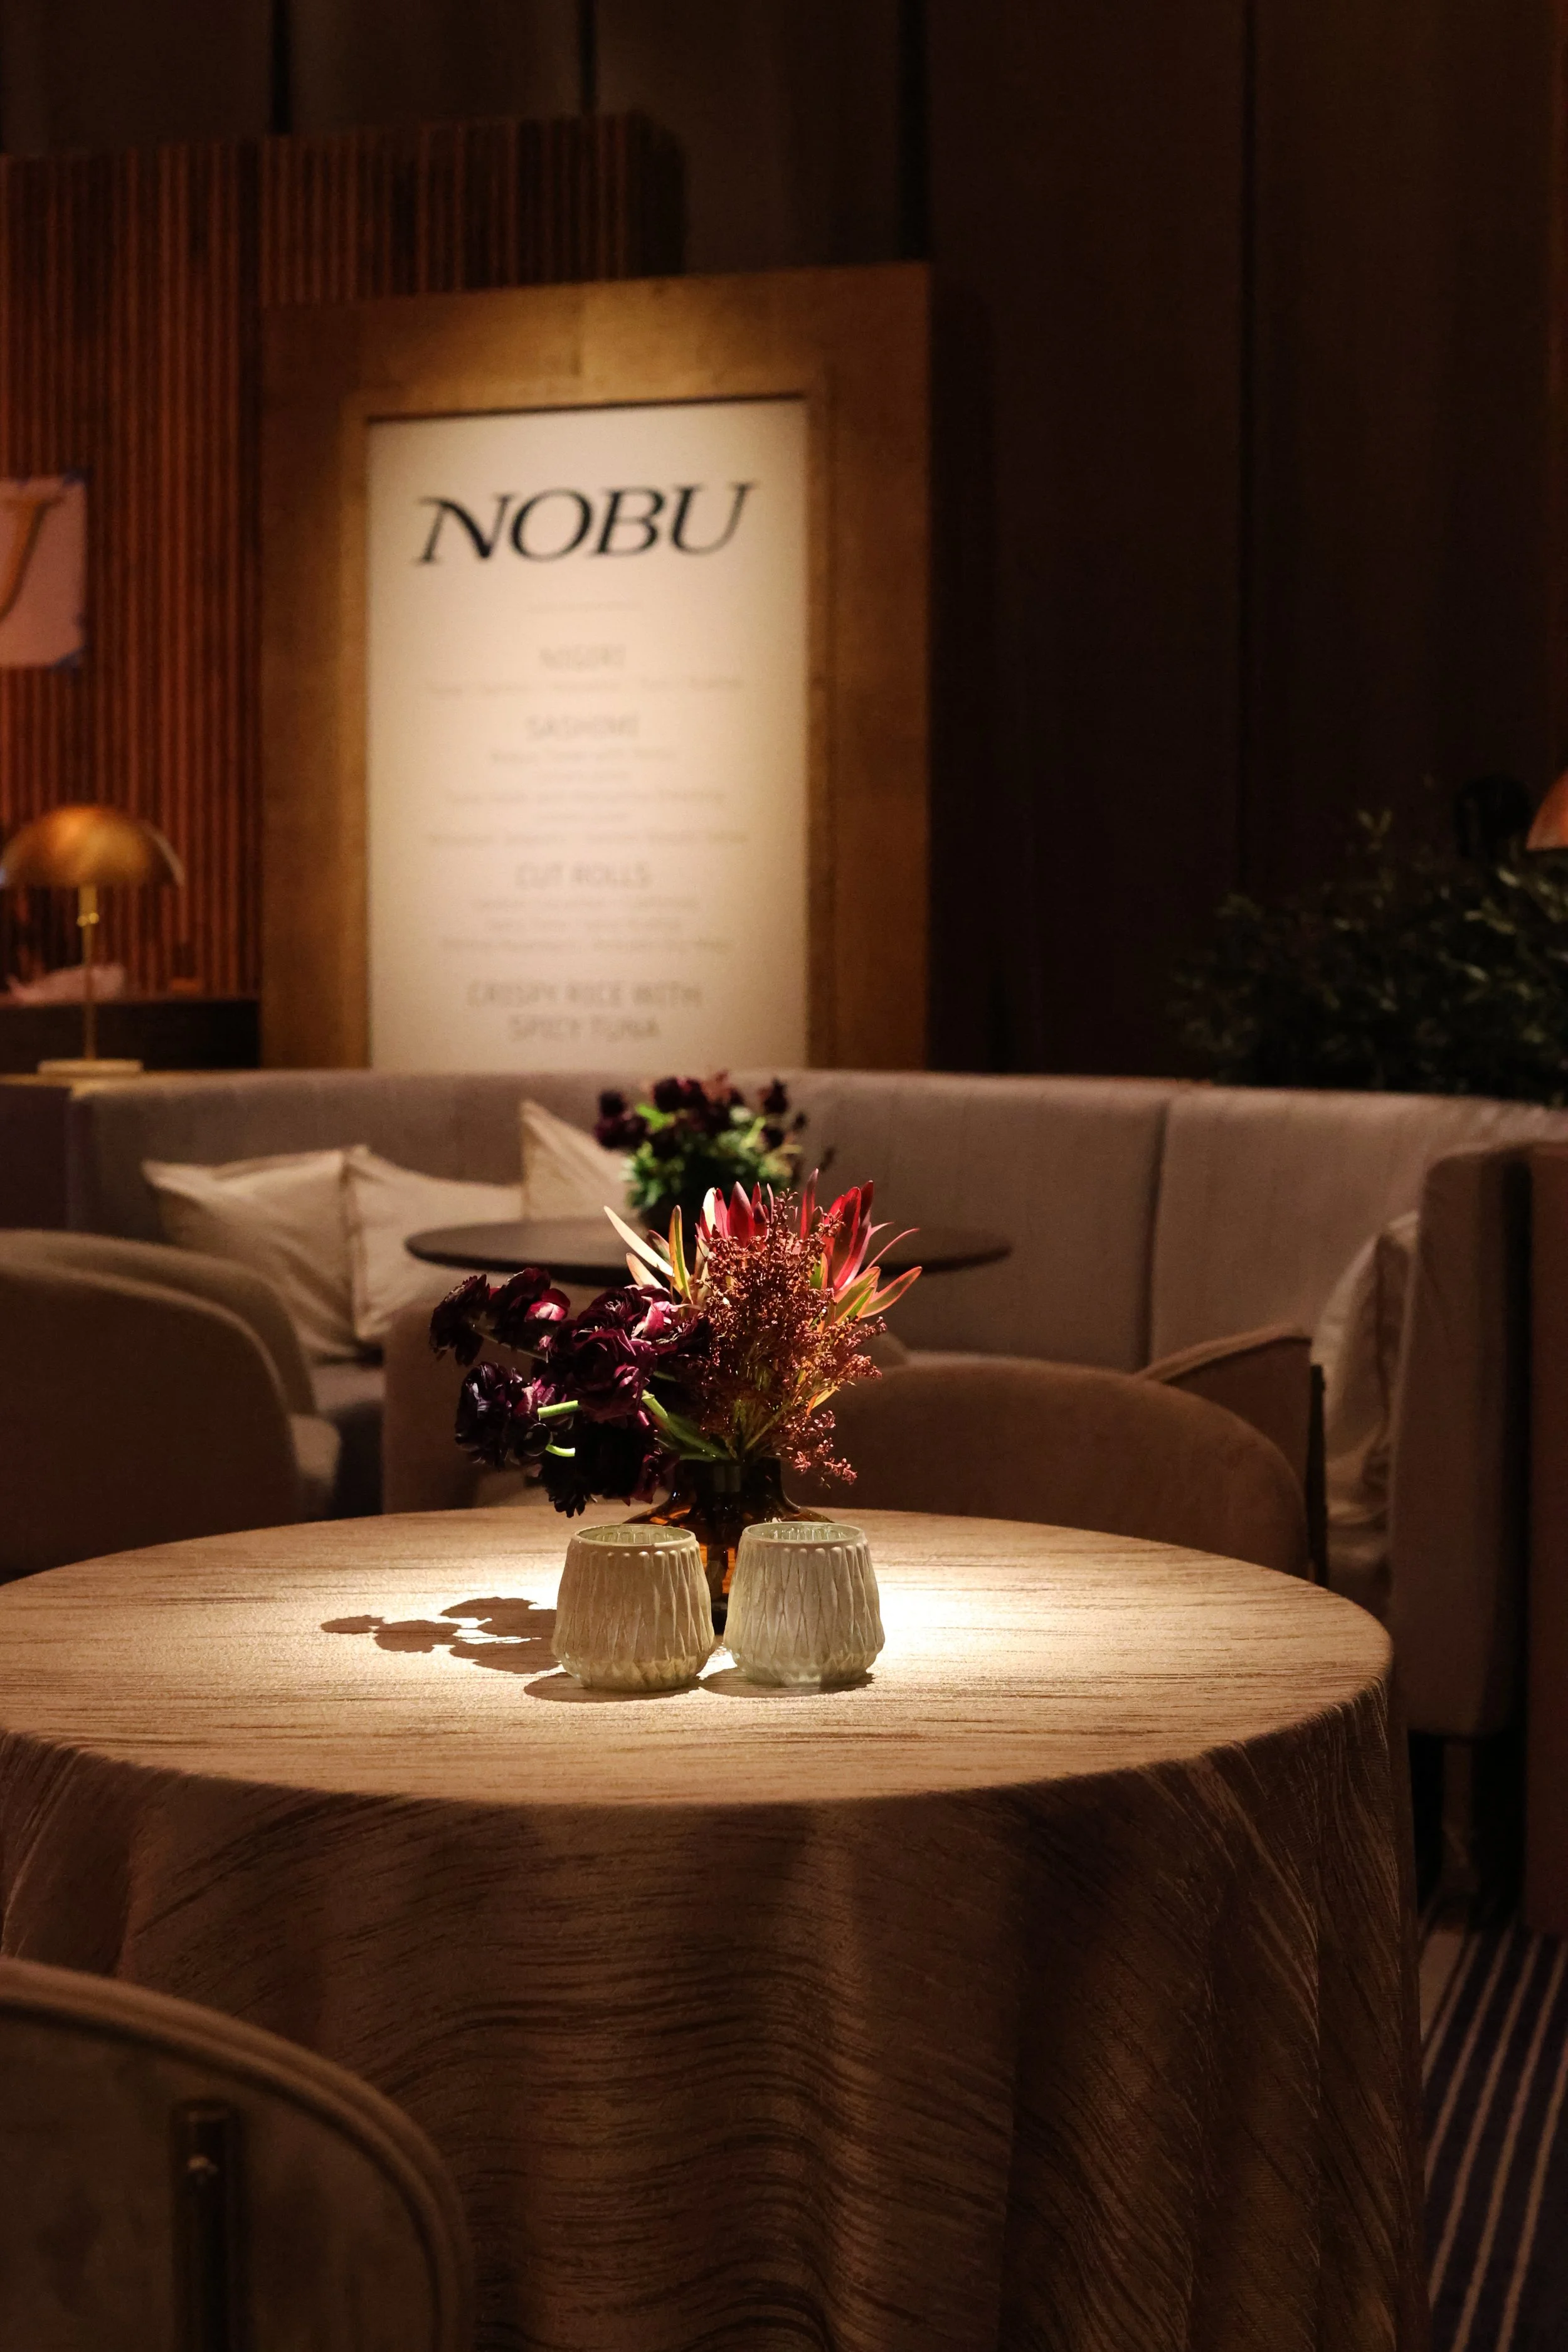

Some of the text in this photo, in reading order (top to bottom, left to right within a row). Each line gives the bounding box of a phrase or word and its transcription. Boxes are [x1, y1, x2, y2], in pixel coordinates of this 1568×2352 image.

[414, 480, 757, 566] NOBU
[514, 861, 651, 889] CUT ROLLS
[467, 980, 702, 1007] CRISPY RICE WITH
